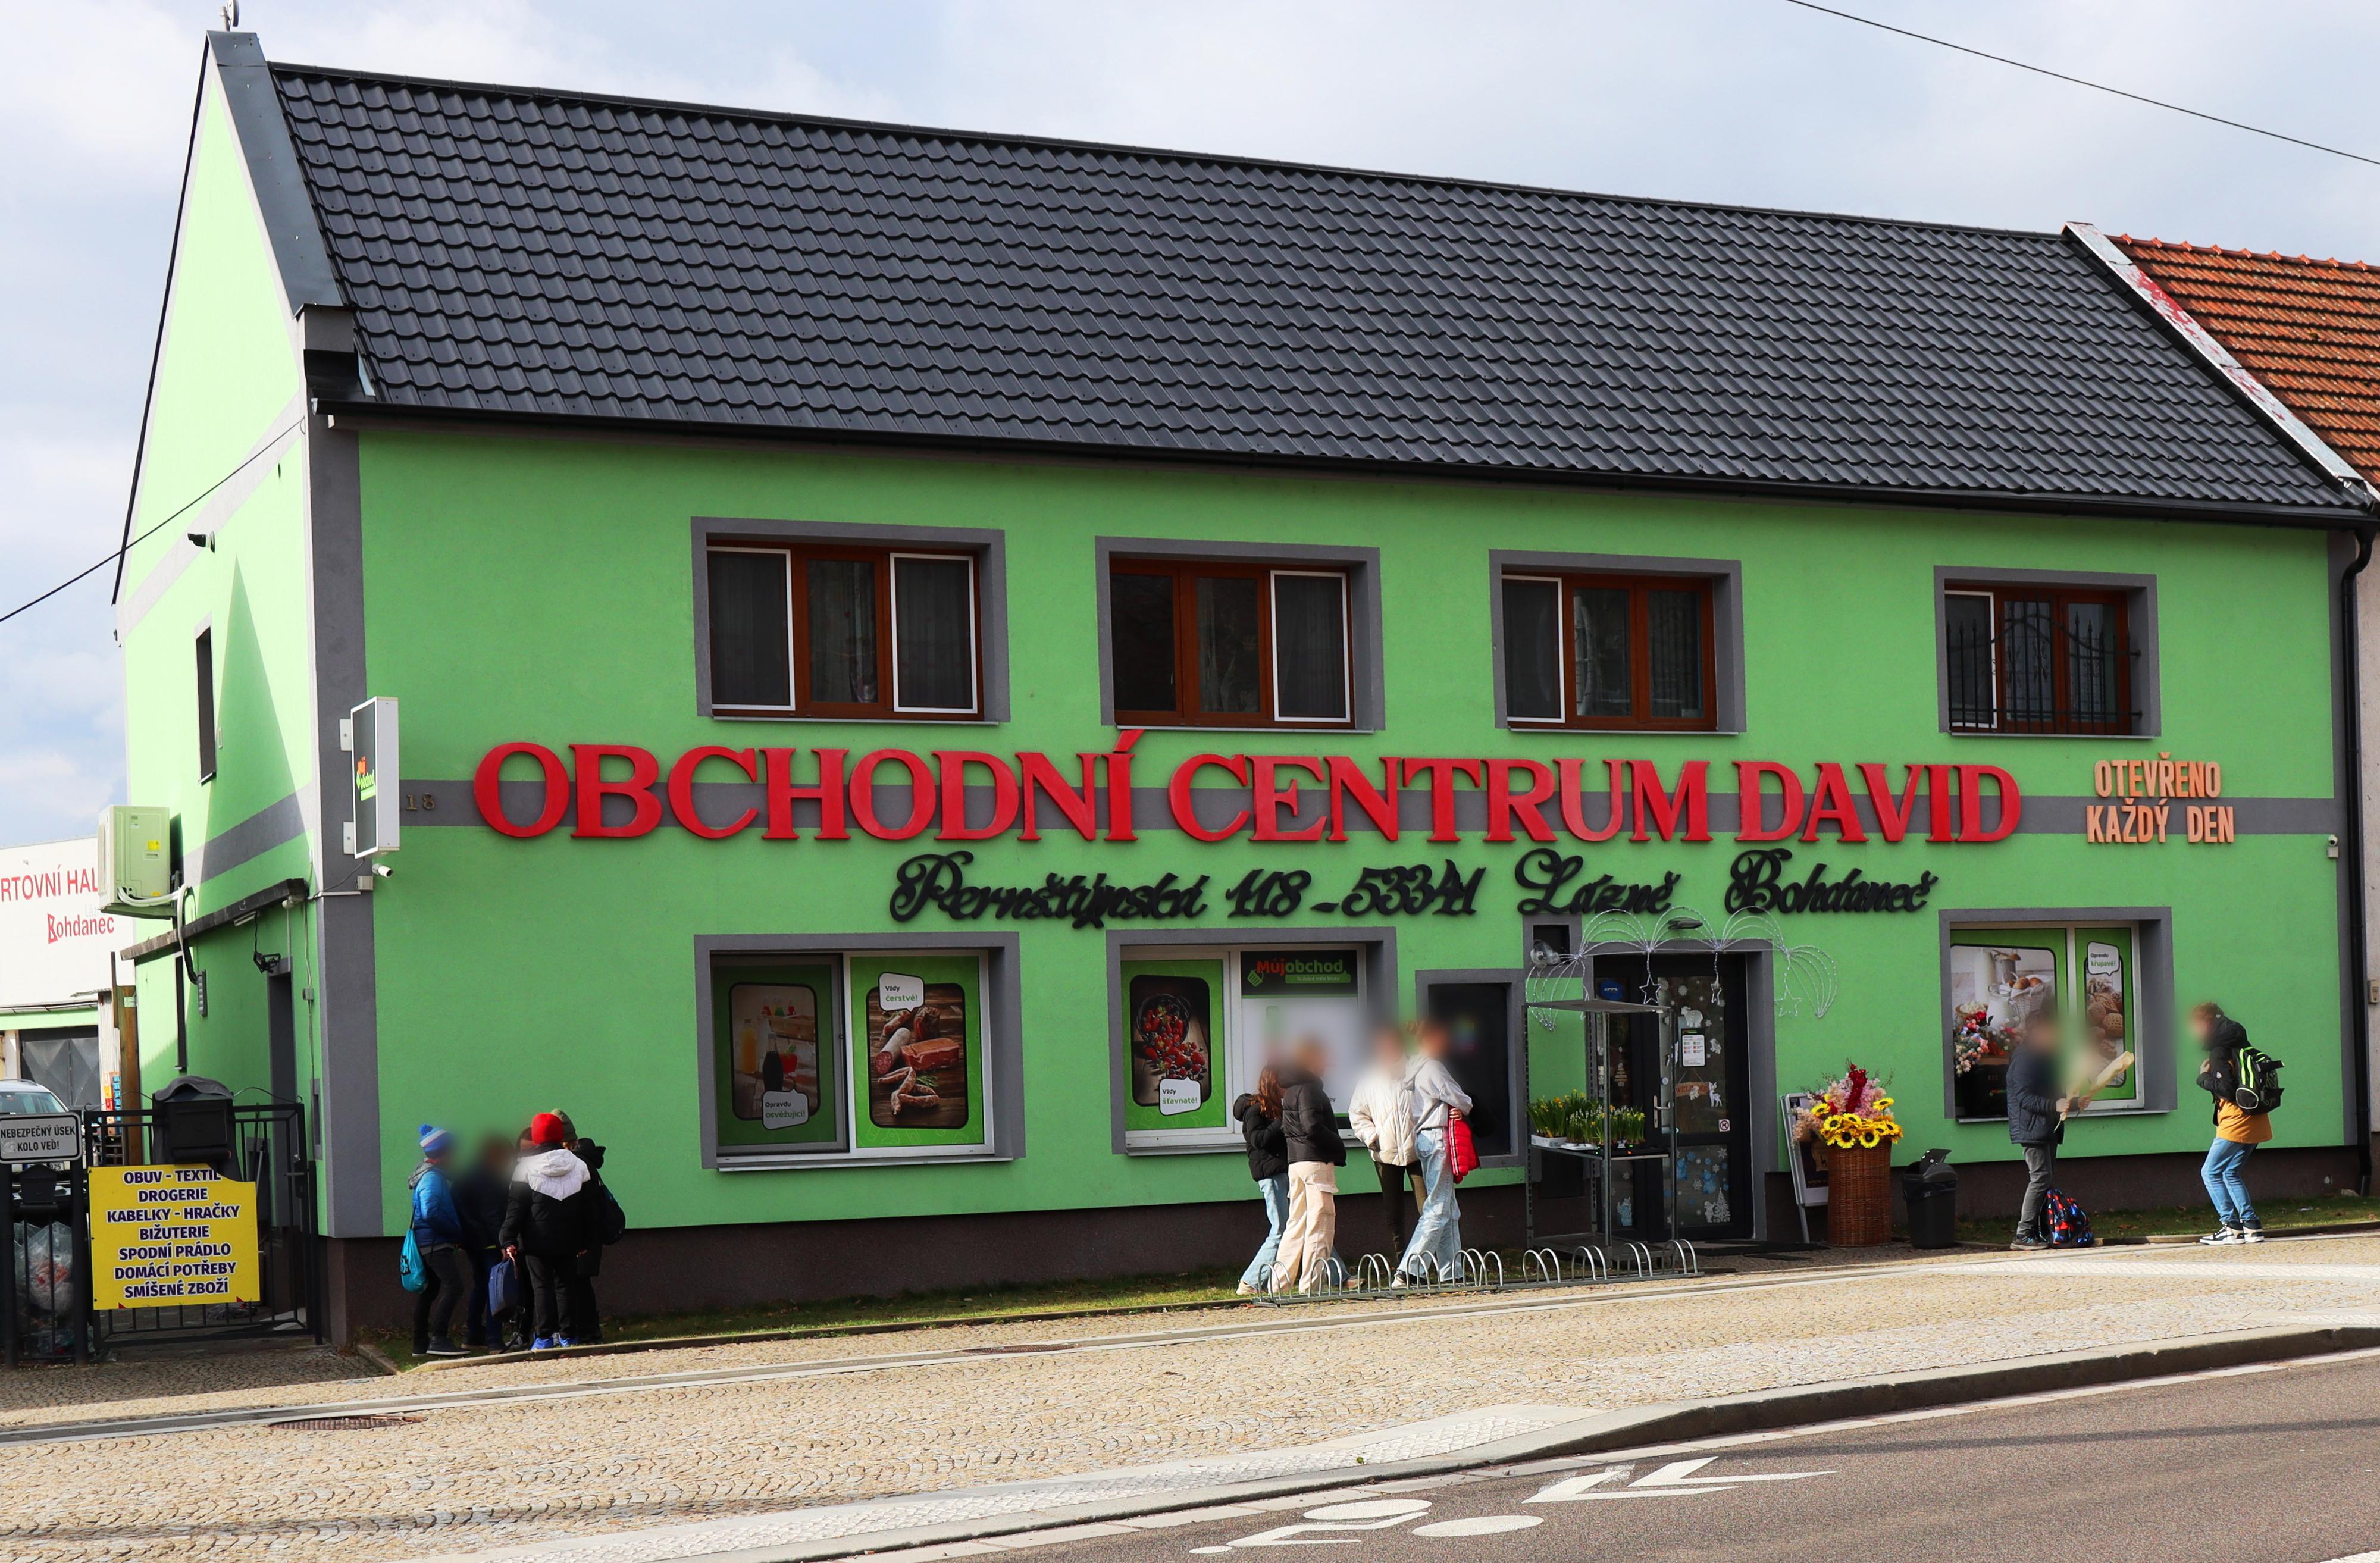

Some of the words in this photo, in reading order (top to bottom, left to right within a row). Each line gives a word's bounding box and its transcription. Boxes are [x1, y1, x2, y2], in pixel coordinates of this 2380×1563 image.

[473, 728, 1144, 841] OBCHODNÍ
[1168, 753, 1714, 841] CENTRUM
[1733, 761, 2021, 842] DAVID
[2094, 751, 2221, 798] OTEVŘENO
[2086, 798, 2170, 843] KAŽDÝ
[2186, 806, 2235, 843] DEN
[1, 864, 61, 902] RTOVNÍ
[67, 867, 99, 895] HAL
[889, 850, 1211, 929] Pernštýnská
[1225, 869, 1312, 918] 118
[1514, 848, 1681, 916] Lázně
[1724, 848, 1939, 914] Bohdaneč
[1, 1125, 52, 1138] NEBEZPEČNÝ
[54, 1124, 76, 1136] ÚSEK
[18, 1142, 39, 1152] KOLO
[123, 1170, 163, 1184] OBUV
[174, 1169, 221, 1182] TEXTIL
[138, 1188, 208, 1202] DROGERIE
[107, 1208, 171, 1223] KABELKY
[183, 1202, 240, 1220] HRAČKY
[139, 1223, 210, 1241] BIŽUTERIE
[118, 1242, 172, 1260] SPODNÍ
[175, 1241, 231, 1258] PRÁDLO
[114, 1261, 170, 1280] DOMÁCÍ
[173, 1259, 237, 1277] POTŘEBY
[124, 1280, 185, 1298] SMÍŠENÉ
[187, 1277, 229, 1295] ZBOŽÍ
